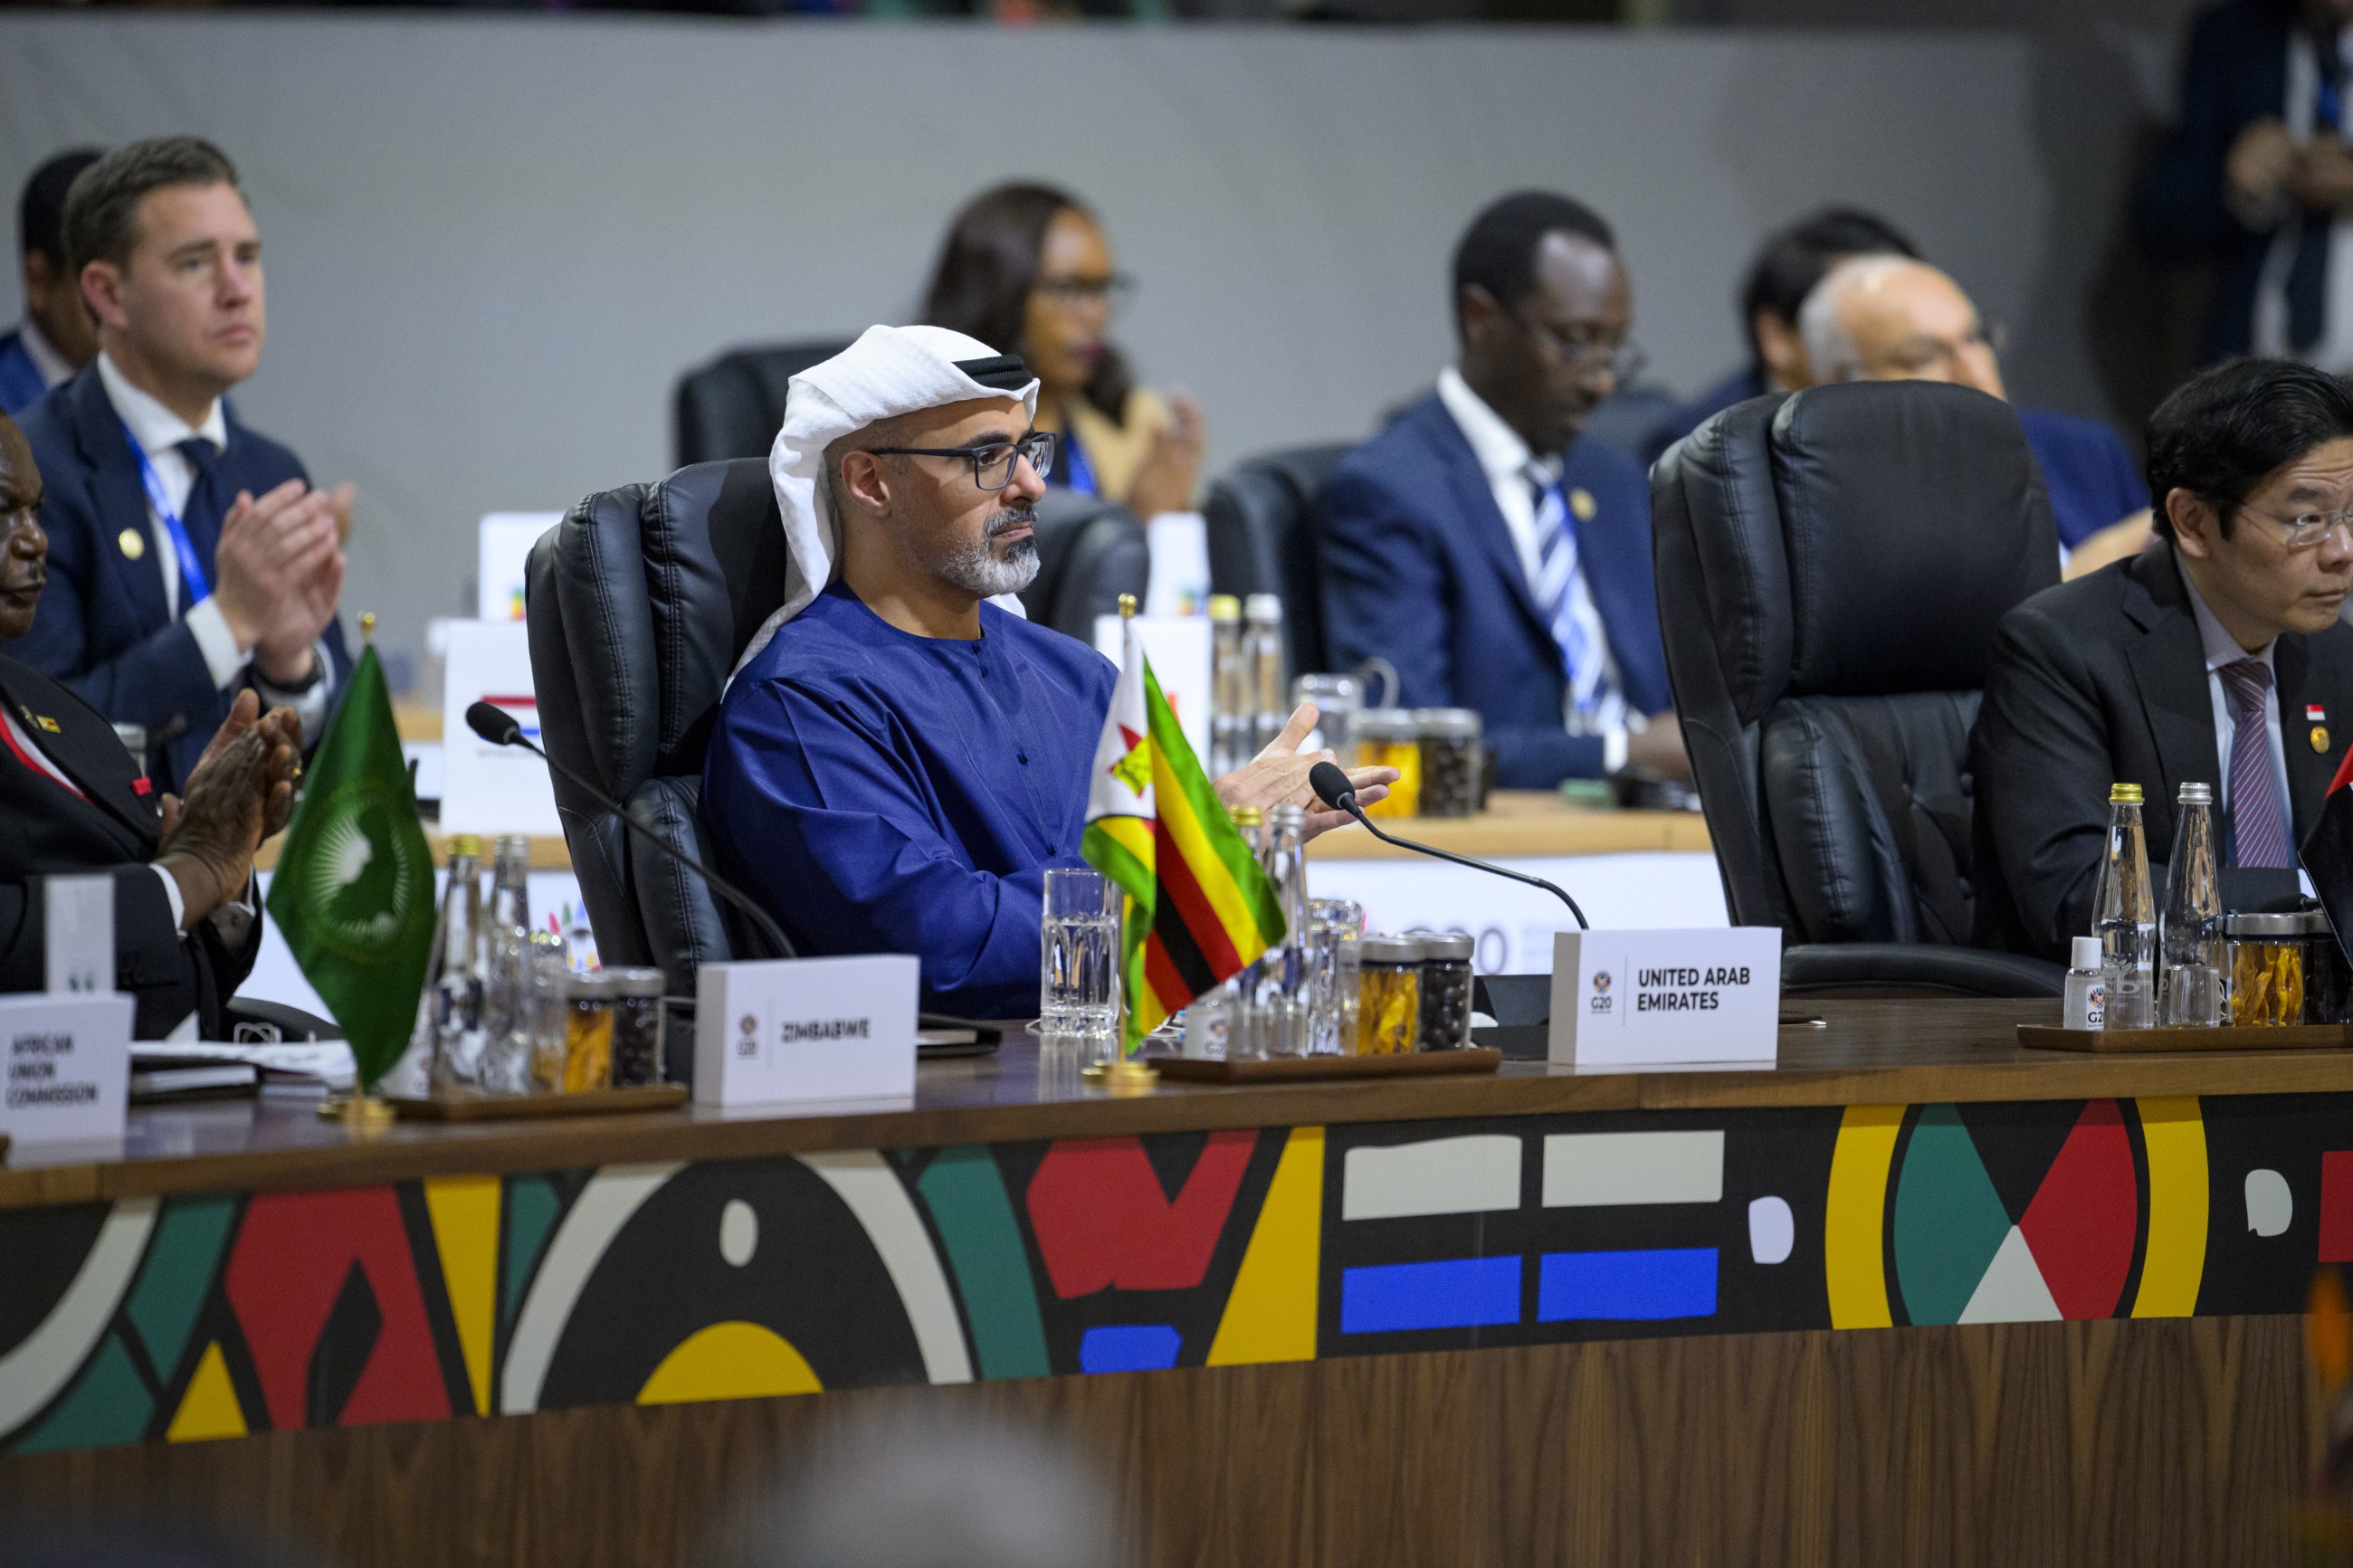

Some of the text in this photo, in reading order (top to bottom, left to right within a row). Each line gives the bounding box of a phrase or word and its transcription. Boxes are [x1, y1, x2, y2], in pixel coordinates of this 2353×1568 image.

[1638, 966, 1750, 987] UNITED ARAB
[1591, 996, 1612, 1009] G20
[1637, 992, 1719, 1012] EMIRATES
[2087, 1012, 2103, 1023] G2
[782, 1018, 871, 1042] ZIMBABWE
